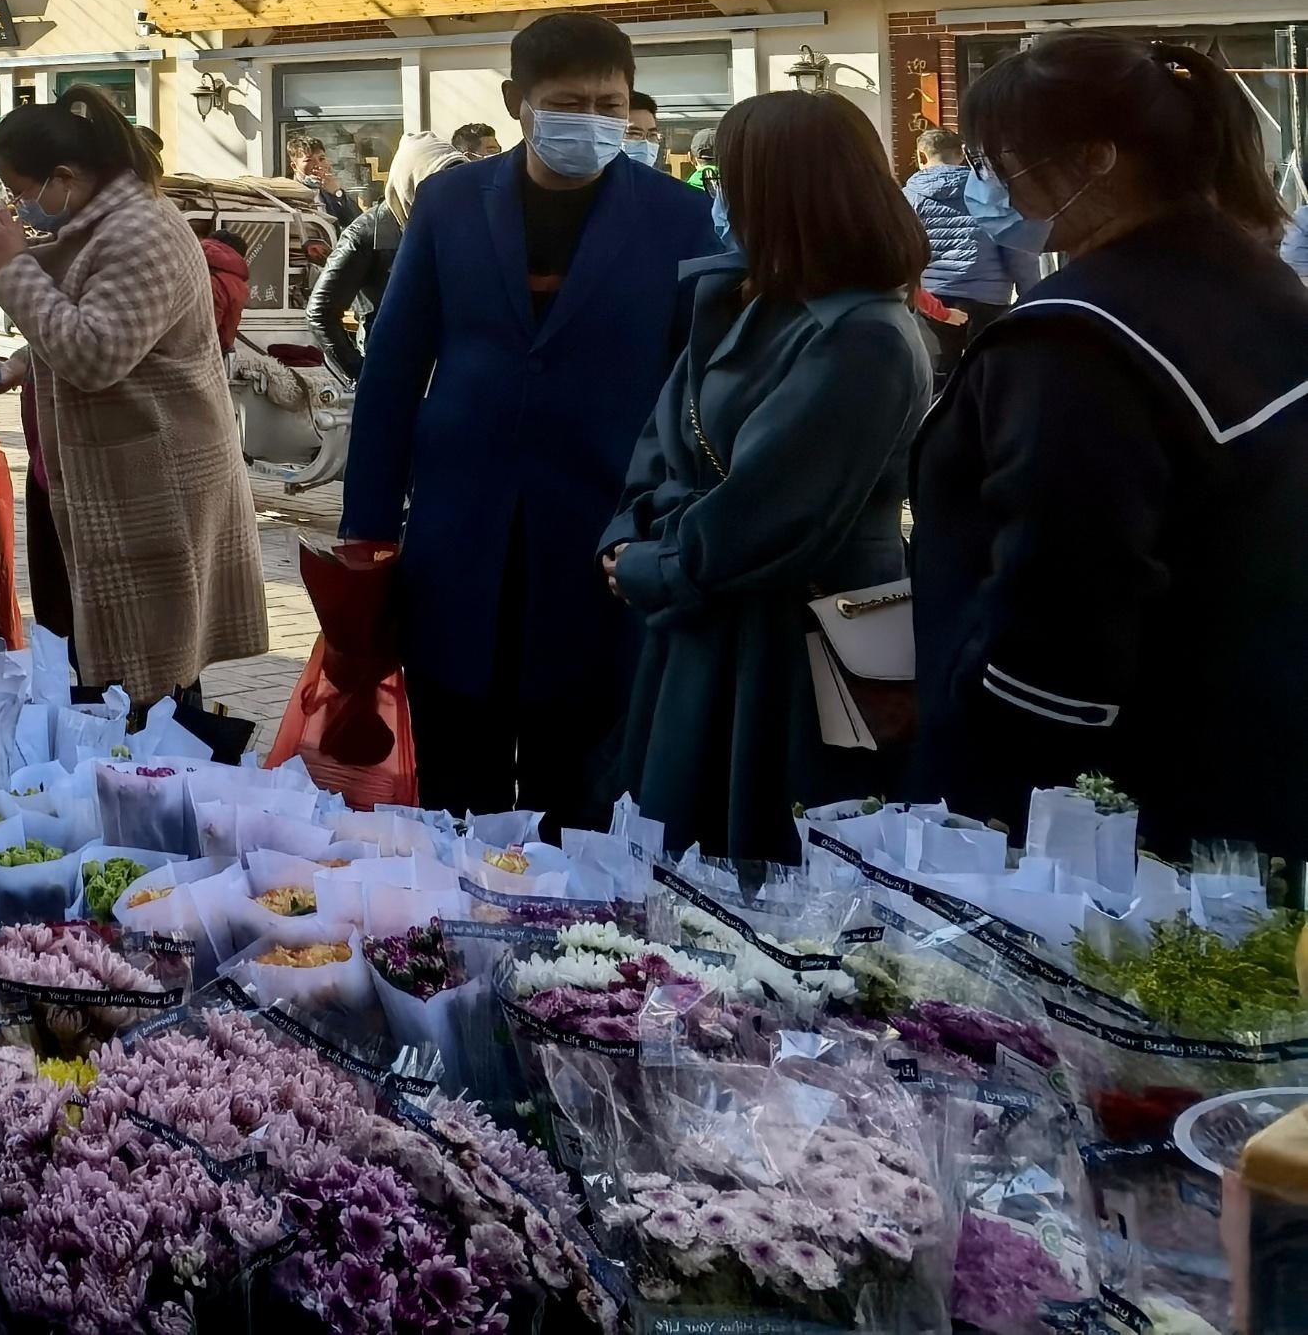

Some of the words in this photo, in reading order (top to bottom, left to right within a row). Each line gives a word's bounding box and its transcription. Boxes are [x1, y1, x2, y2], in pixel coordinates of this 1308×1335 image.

[874, 870, 906, 891] Beauty
[1038, 963, 1065, 983] Your
[48, 990, 70, 1002] Your
[73, 991, 108, 1007] Beauty
[110, 993, 137, 1005] Hifun
[138, 995, 161, 1007] Your
[308, 1036, 325, 1052] Your
[541, 1025, 559, 1040] Your
[563, 1033, 581, 1047] Life
[589, 1040, 635, 1057] Blooming
[1107, 1030, 1138, 1047] Your
[1143, 1039, 1185, 1056] Beauty
